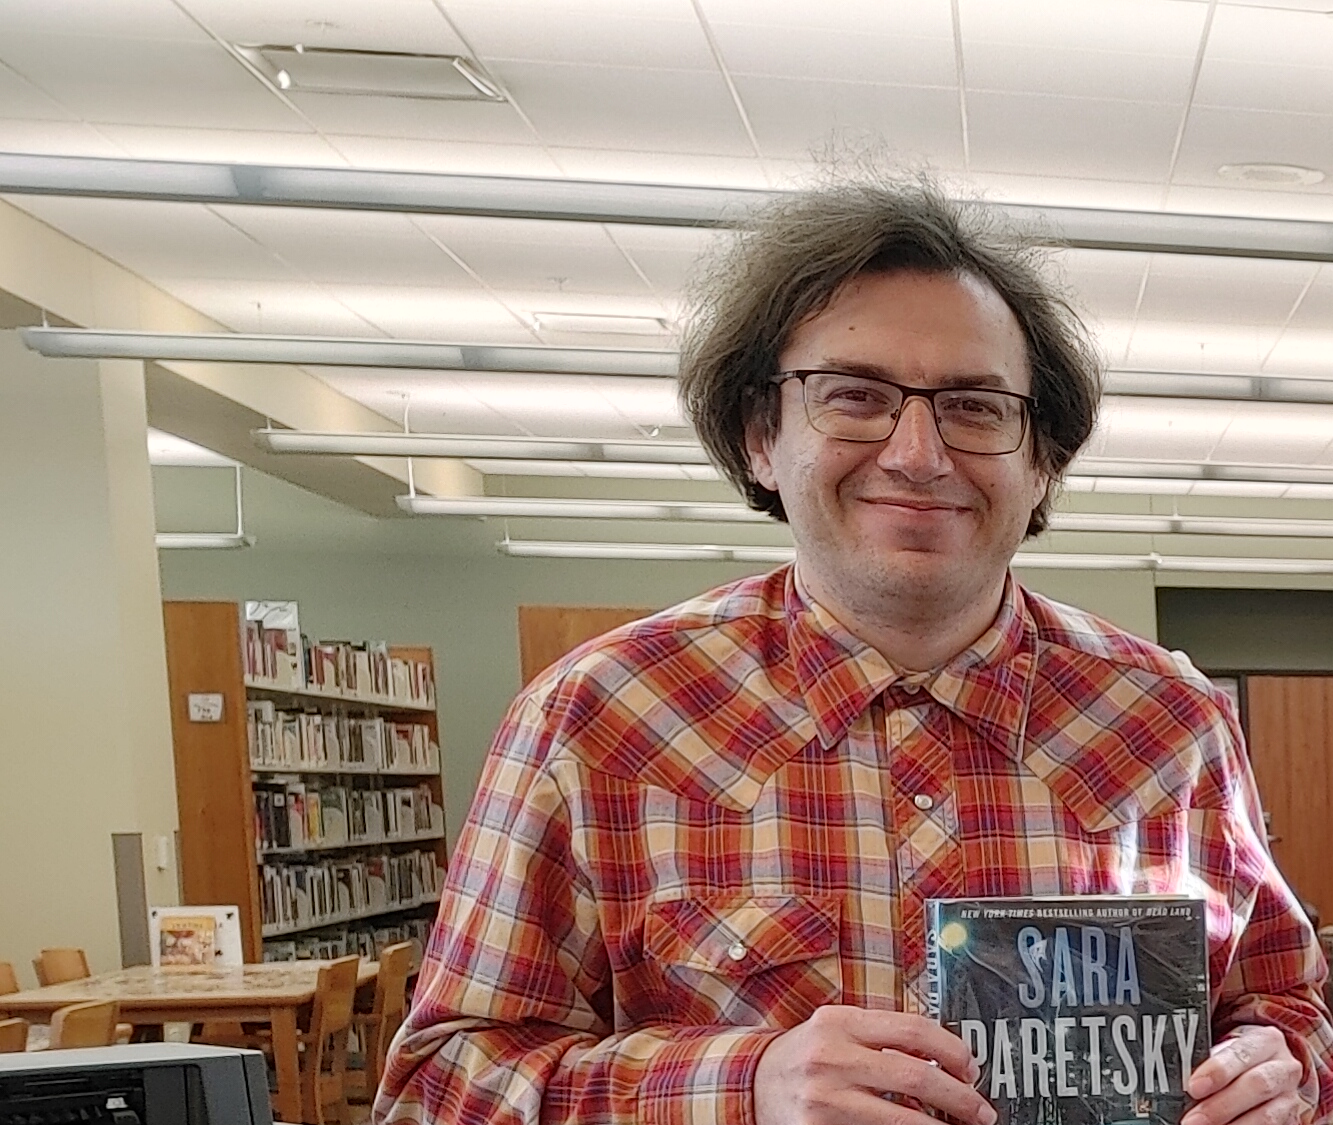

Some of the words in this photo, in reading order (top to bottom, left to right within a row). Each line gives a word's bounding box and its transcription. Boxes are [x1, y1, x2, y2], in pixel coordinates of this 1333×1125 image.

[961, 909, 980, 919] NEW
[1007, 908, 1034, 918] TIMES
[1037, 908, 1093, 918] BESTSELLING
[1096, 907, 1129, 917] AUTHOR
[1132, 907, 1142, 917] OF
[1170, 906, 1191, 917] LAND
[1018, 926, 1141, 1008] SARA
[961, 1013, 1199, 1099] PARETSKY
